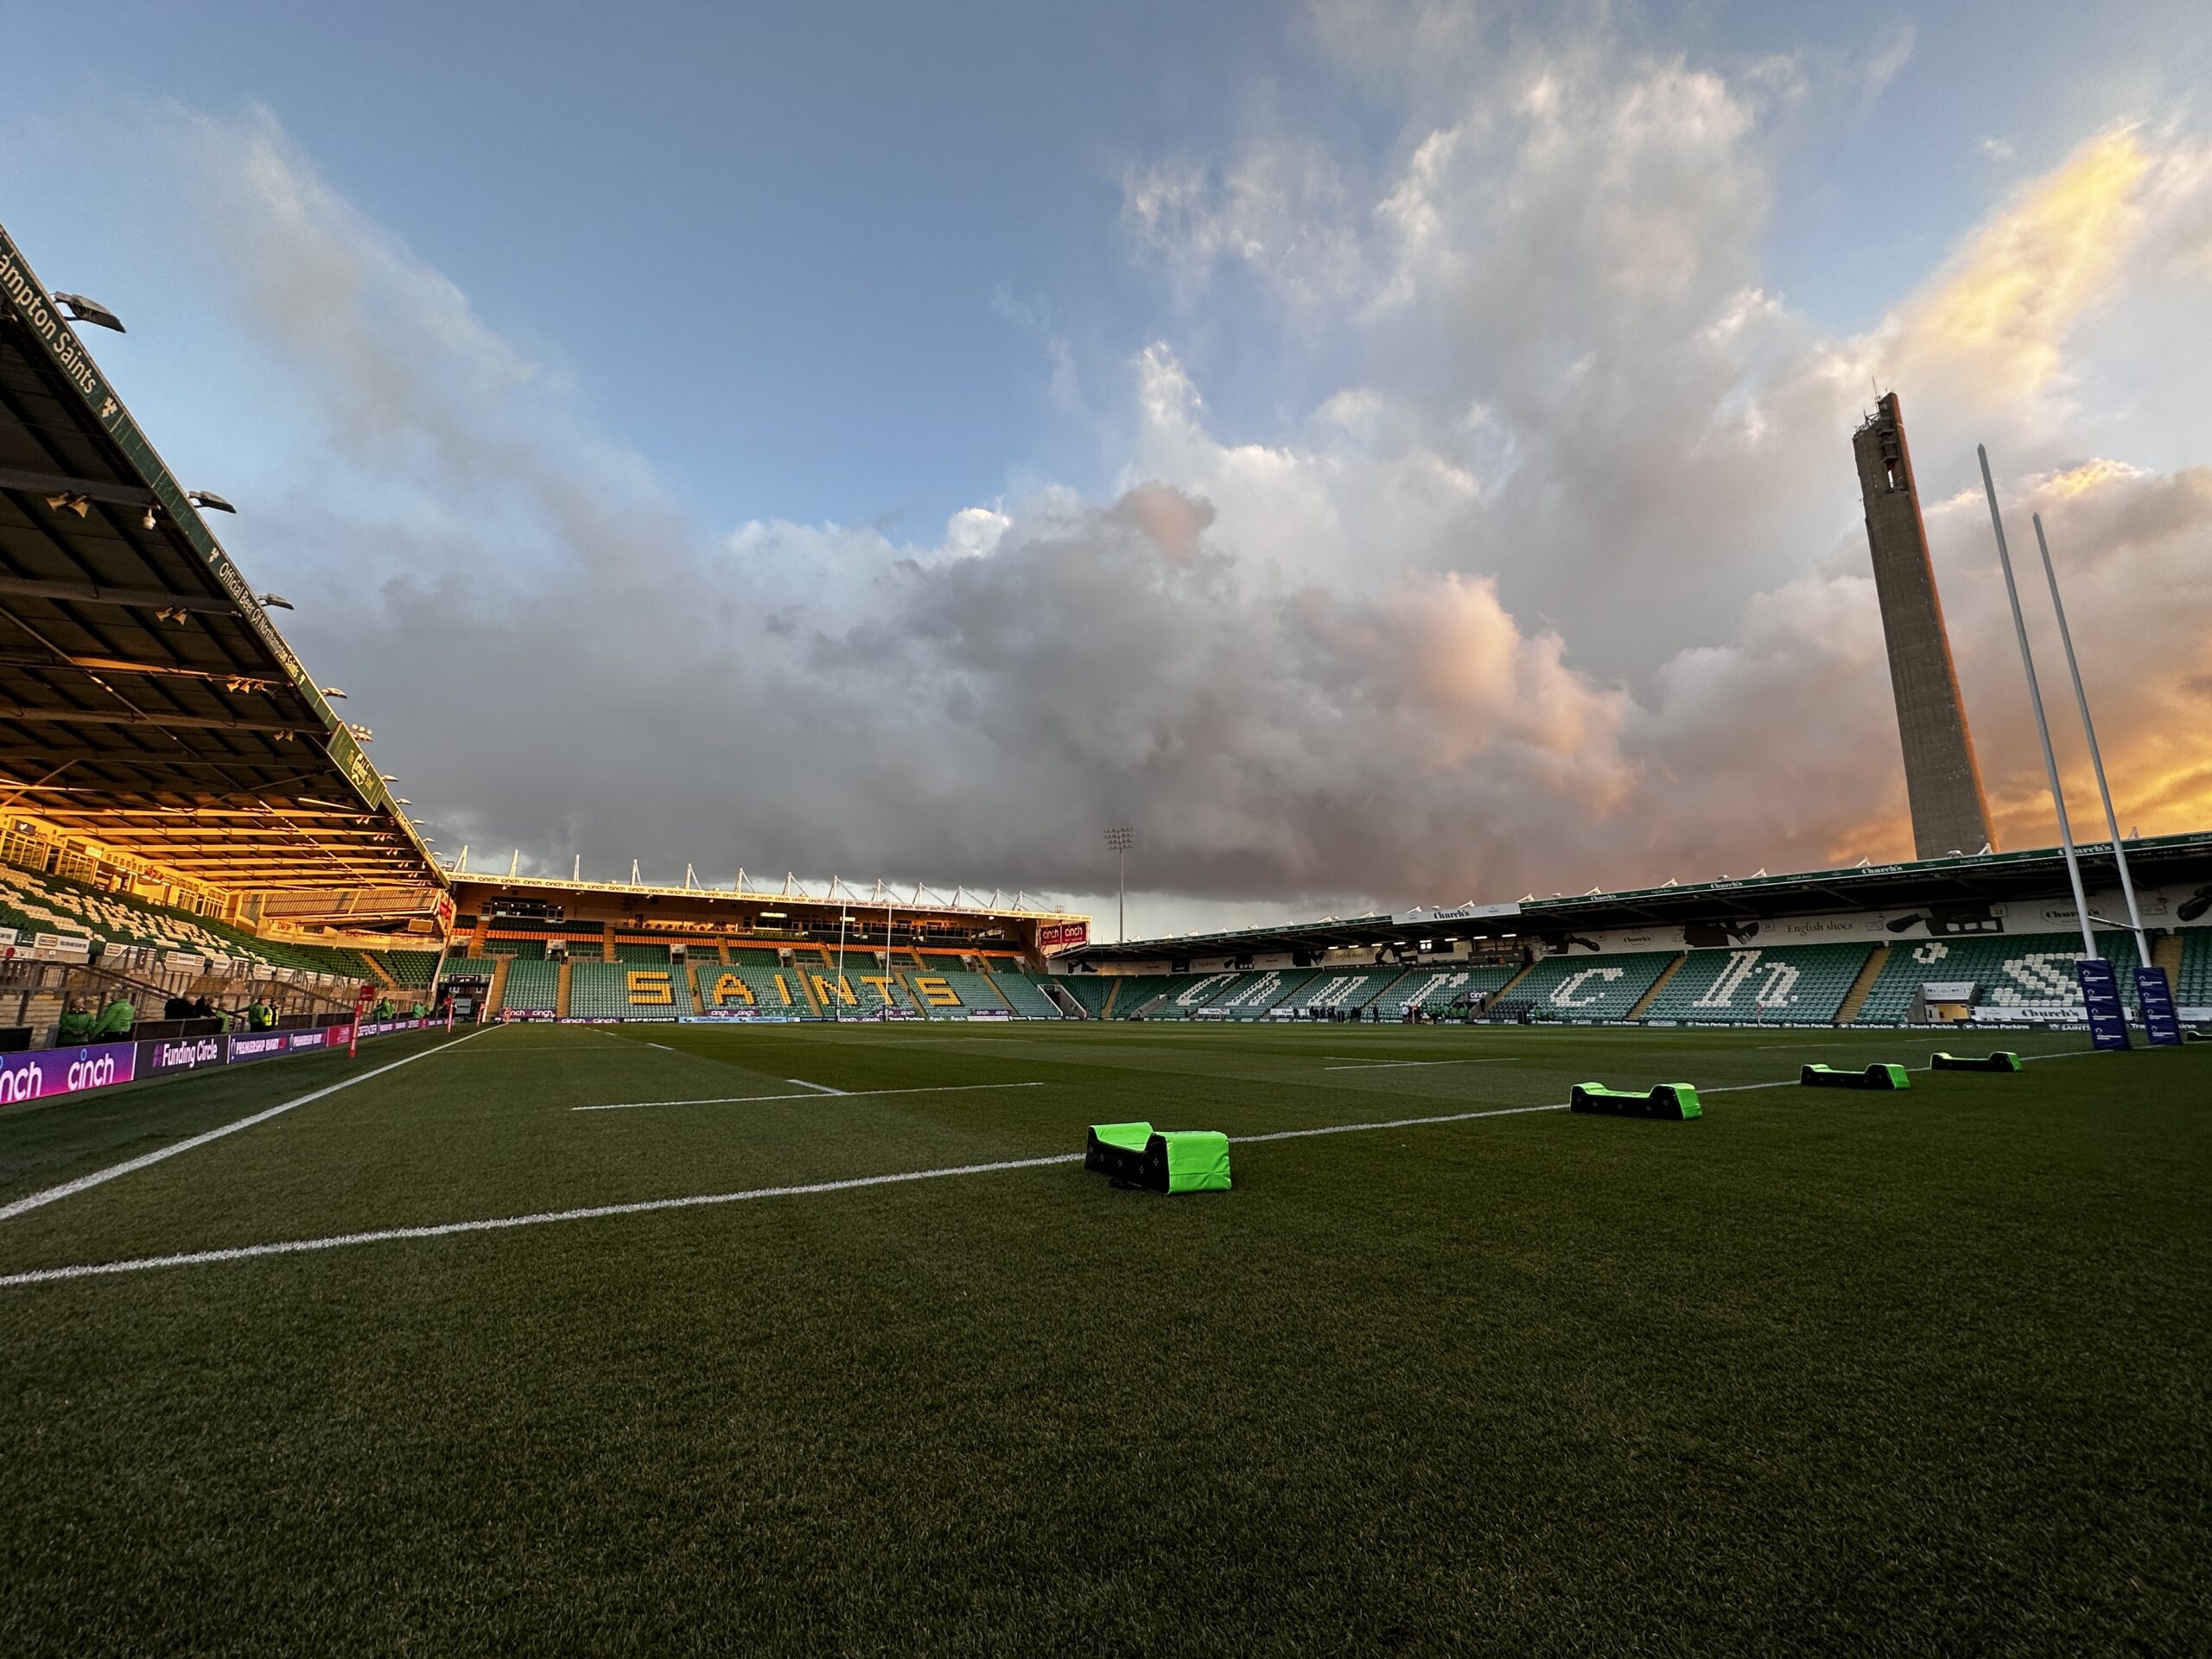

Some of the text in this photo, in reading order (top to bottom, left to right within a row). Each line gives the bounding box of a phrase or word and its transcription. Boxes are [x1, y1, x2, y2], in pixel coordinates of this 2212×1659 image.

[0, 254, 97, 393] ampton Saints
[219, 562, 300, 678] Official Beer Of Northampton Saints
[2057, 845, 2112, 855] Curch's
[1861, 864, 1903, 874] Church's
[1710, 880, 1744, 889] Church's
[1433, 909, 1471, 919] Church's
[2045, 909, 2100, 918] Chur's
[1043, 928, 1059, 939] cinch
[1065, 925, 1083, 938] cinch
[1787, 919, 1853, 937] English shoes
[627, 970, 964, 1007] SAINTS
[2021, 1008, 2080, 1018] Church's
[162, 1039, 218, 1068] Funding Circle
[0, 1048, 115, 1103] nch cinch
